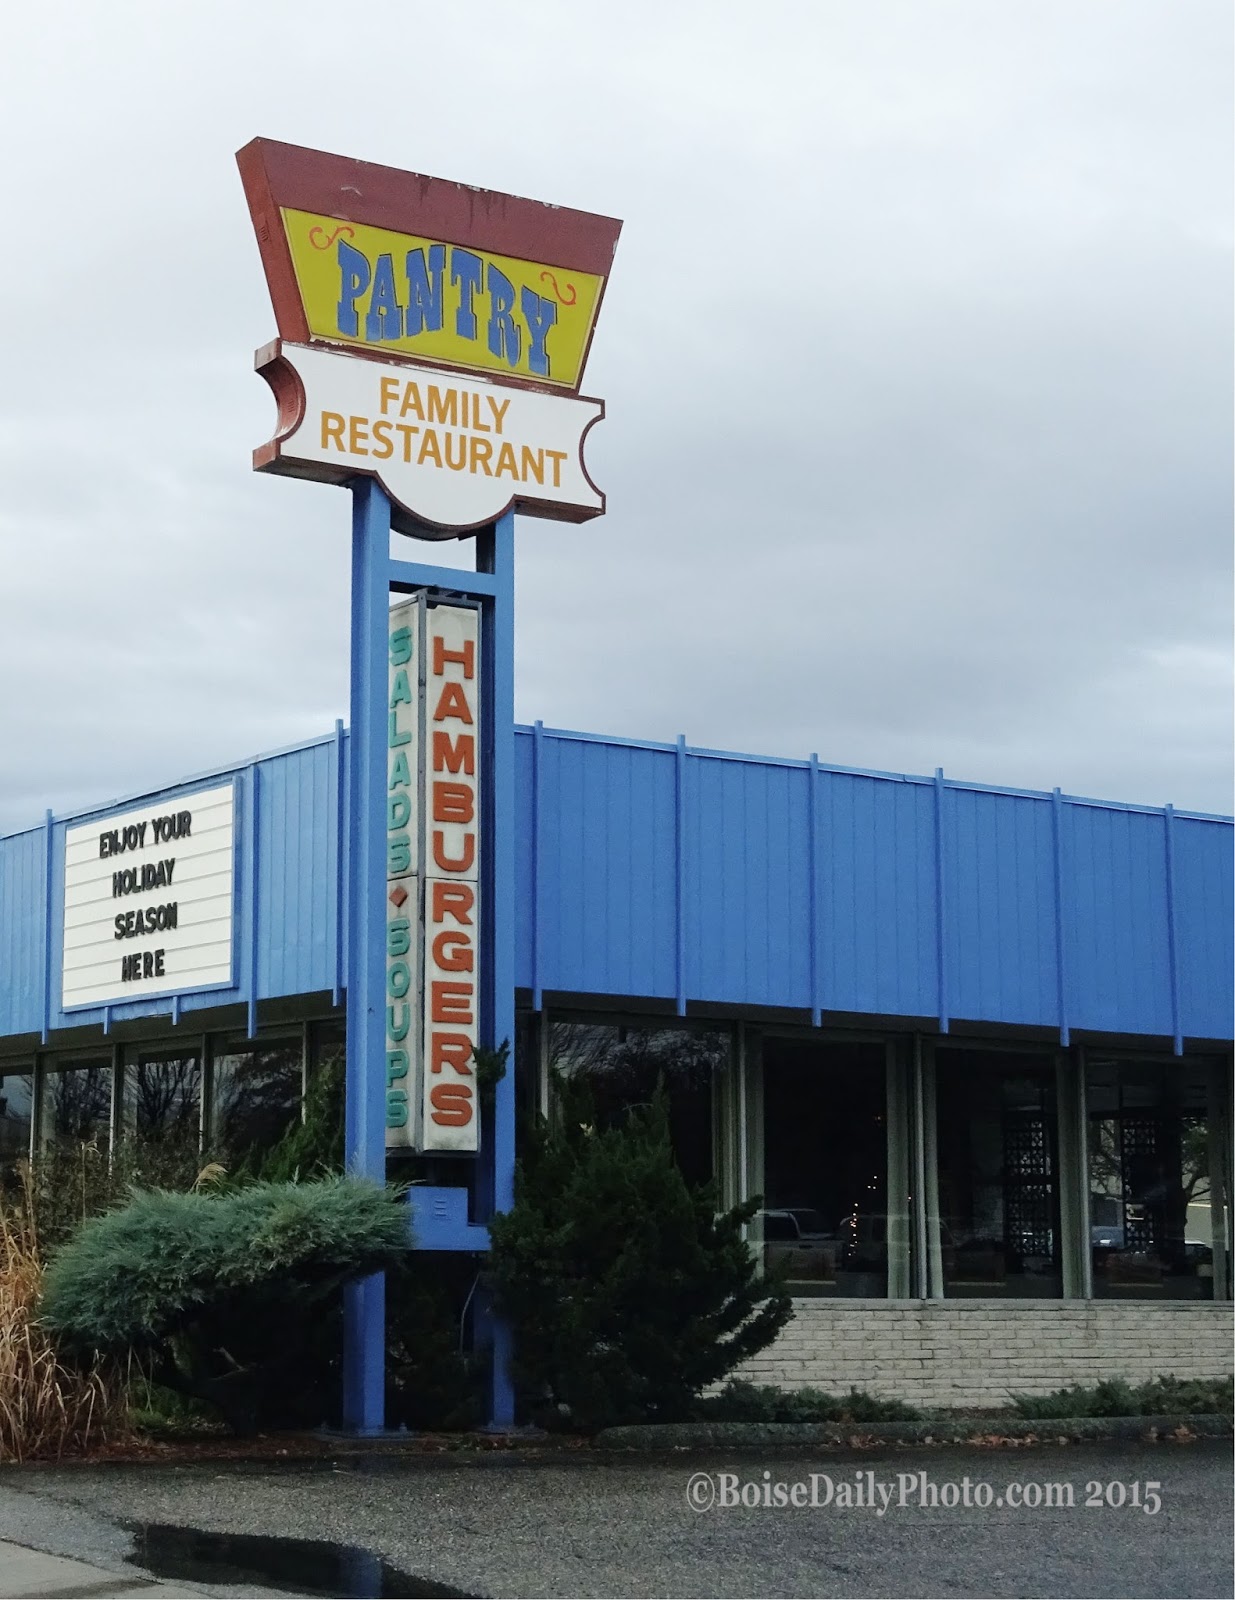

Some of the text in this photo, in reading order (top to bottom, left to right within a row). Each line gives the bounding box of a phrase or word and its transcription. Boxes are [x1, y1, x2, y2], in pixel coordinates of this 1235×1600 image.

[337, 238, 558, 377] PANTRY
[380, 376, 511, 435] FAMILY
[320, 410, 568, 488] RESTAURANT
[99, 810, 192, 859] ENJOY YOUR
[112, 858, 176, 898] HOLIDAY
[385, 625, 413, 1128] SALADS SOUPS
[430, 636, 475, 1127] HAMBURGERS
[114, 902, 178, 940] SEASON
[121, 949, 165, 982] HERE
